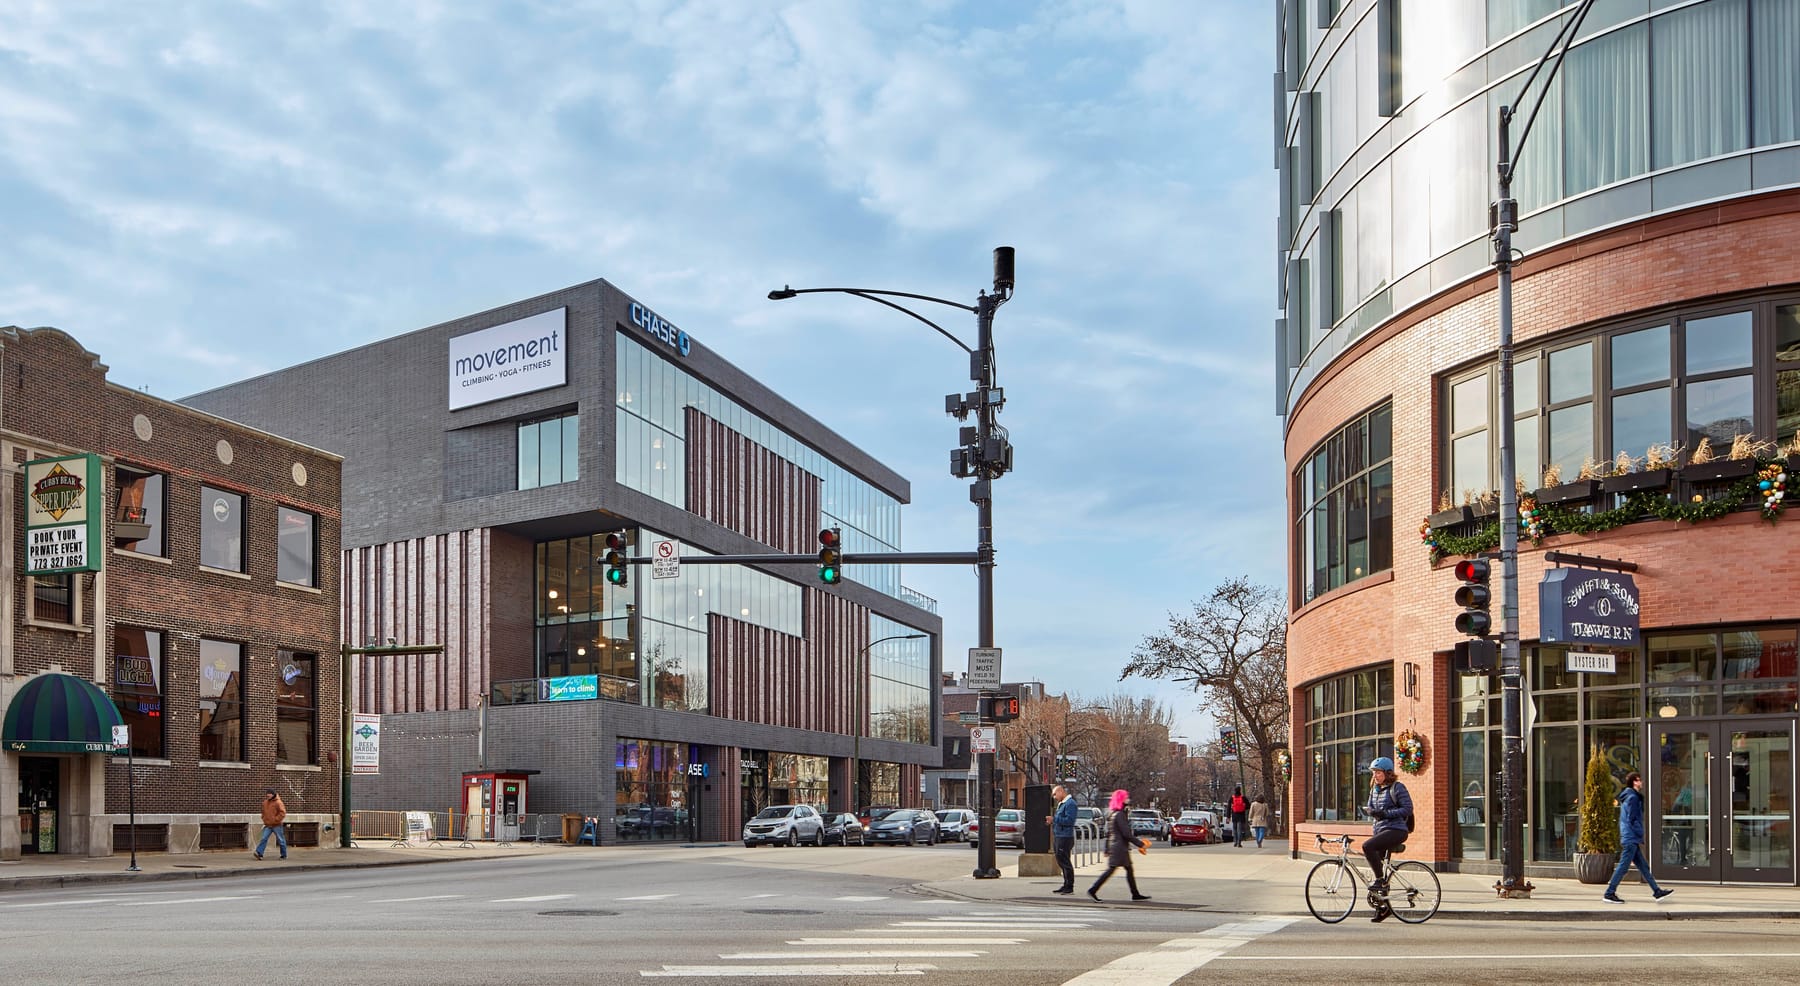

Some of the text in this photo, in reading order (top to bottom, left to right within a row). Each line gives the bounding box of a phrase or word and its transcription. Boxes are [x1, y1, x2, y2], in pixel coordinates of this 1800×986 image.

[630, 302, 677, 348] CHASE
[456, 330, 558, 376] movement
[462, 359, 552, 387] CLIMBING YOGA FITNESS
[41, 476, 76, 489] CUBBY BEAR
[34, 529, 76, 543] BOOK YOUR
[30, 542, 83, 557] PRIVATE EVENT
[34, 555, 82, 570] 773 327 1662
[1566, 579, 1599, 607] SWIFT
[1611, 583, 1639, 615] SONS
[1571, 622, 1632, 640] TAVERN
[123, 658, 148, 671] BUD
[1574, 656, 1609, 668] OYSTER BAR
[120, 669, 152, 683] LIGHT
[577, 684, 595, 692] climb
[741, 760, 750, 768] TACO
